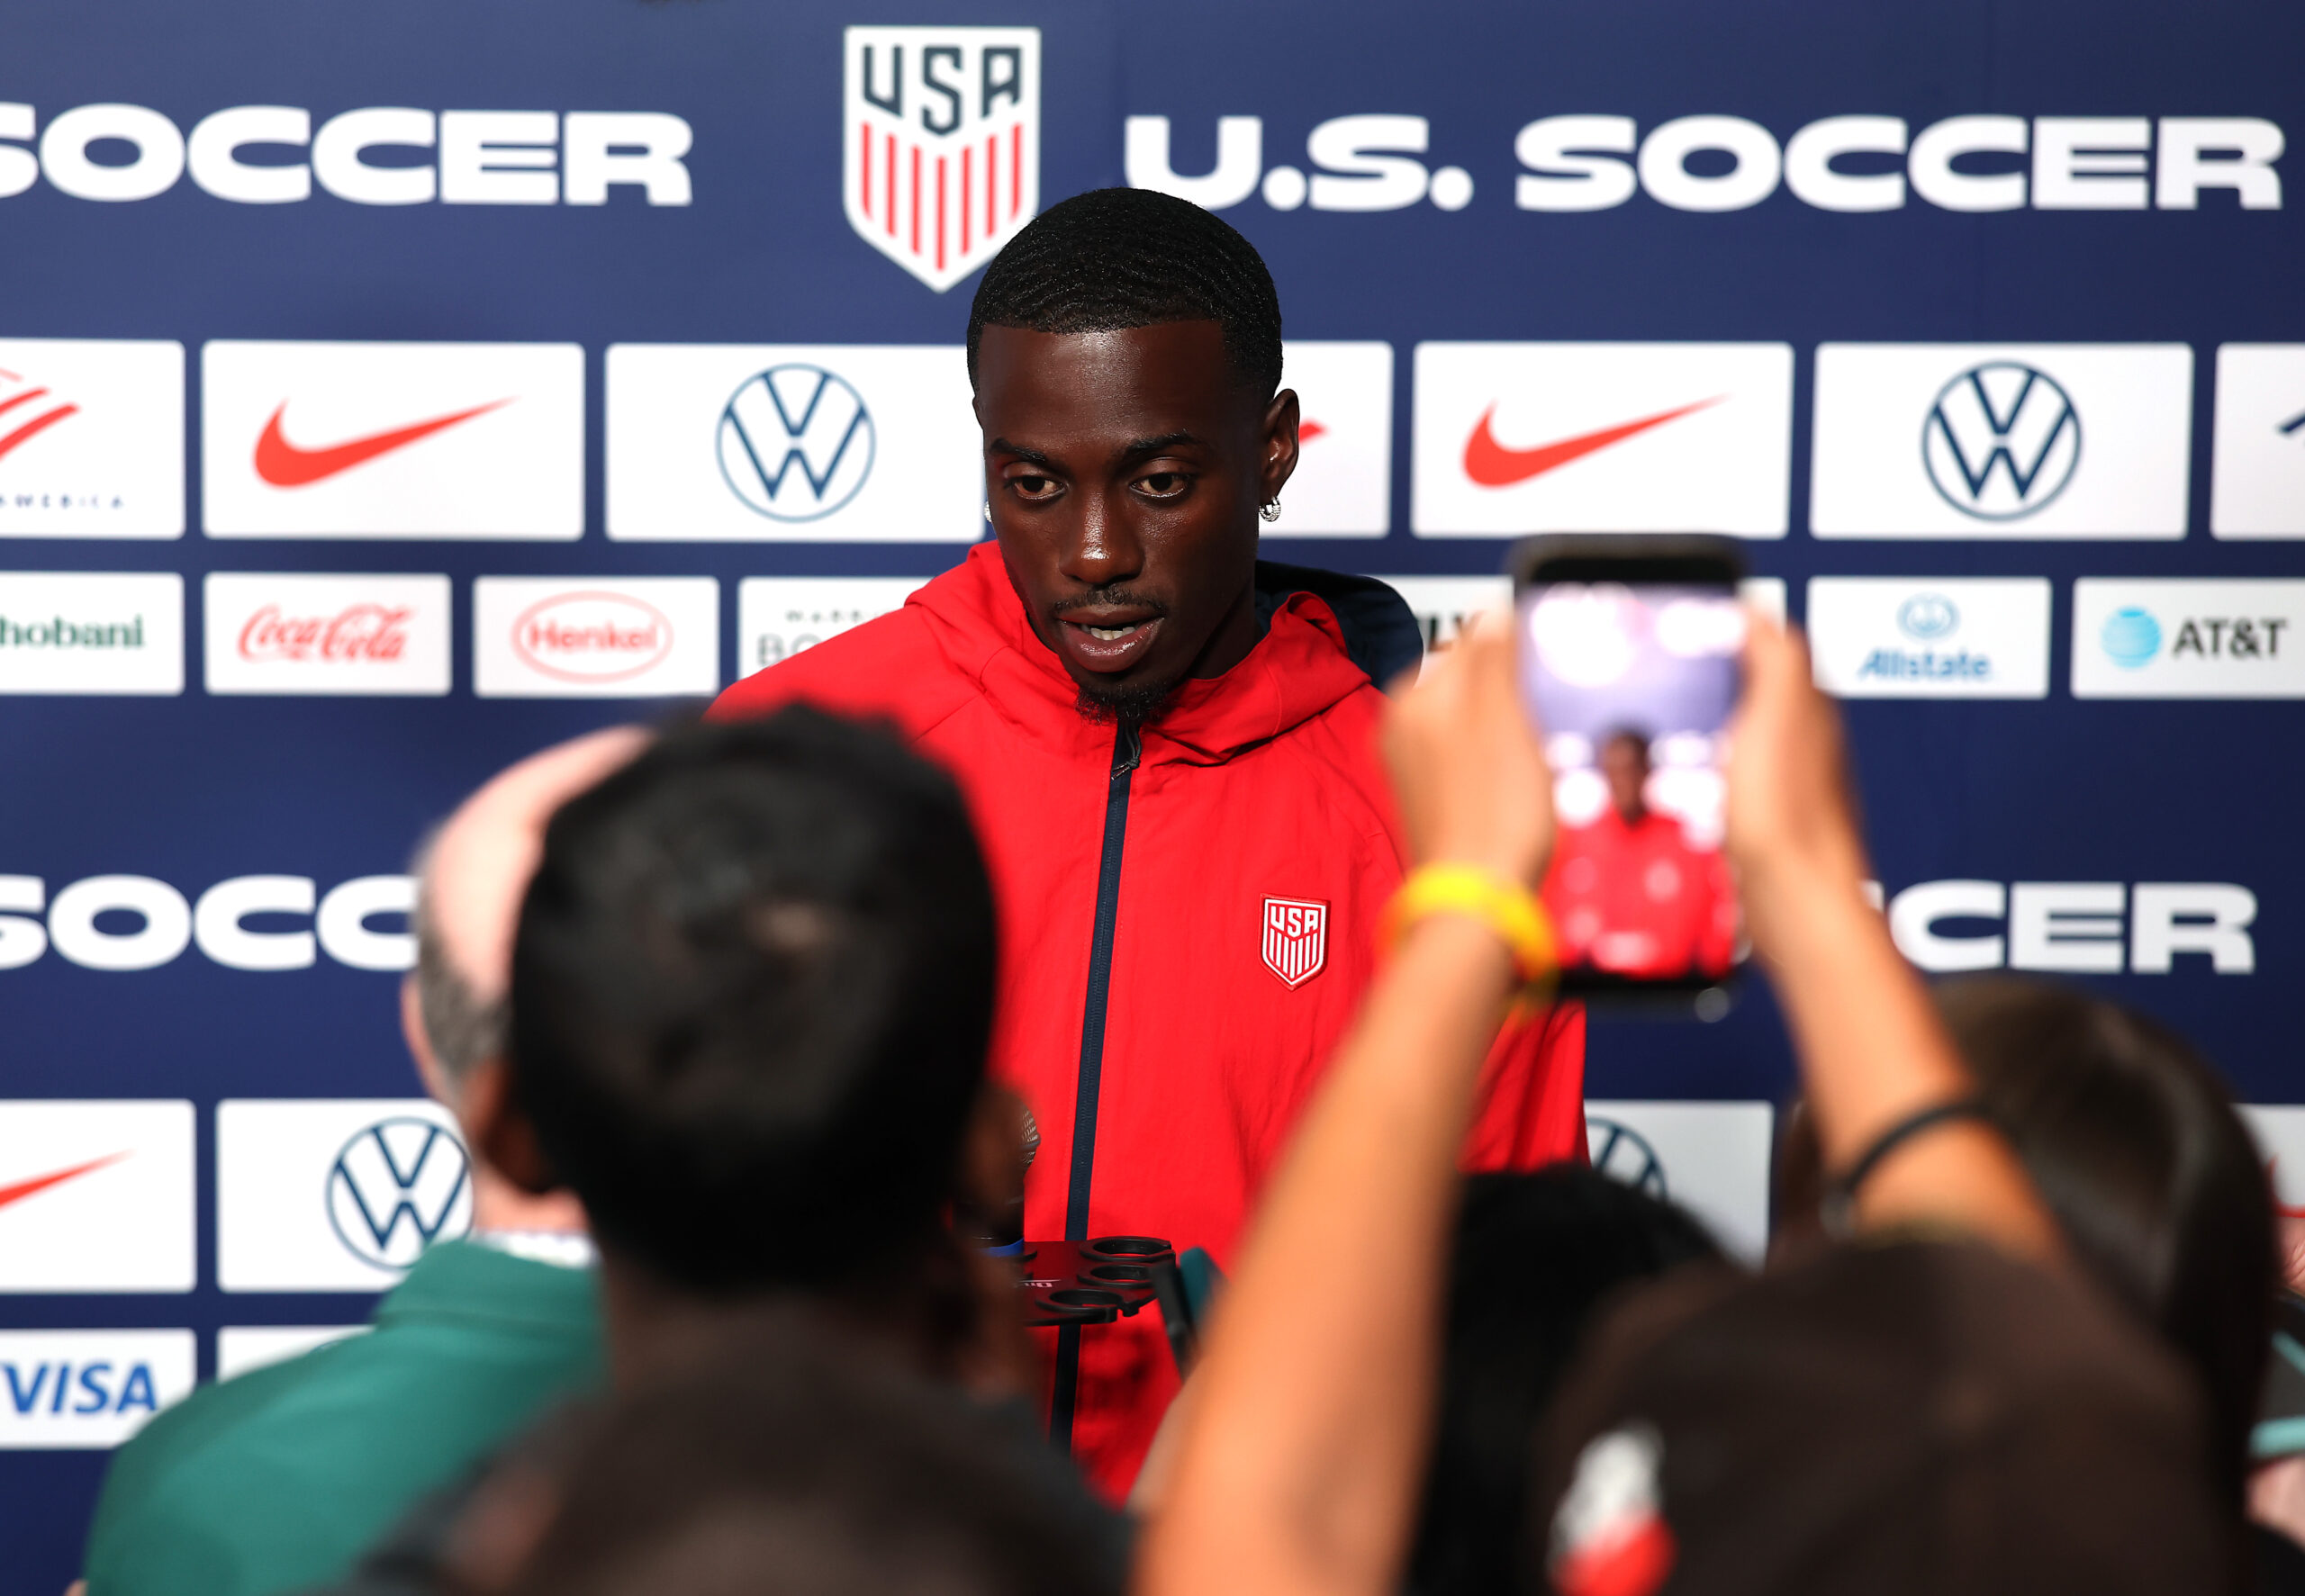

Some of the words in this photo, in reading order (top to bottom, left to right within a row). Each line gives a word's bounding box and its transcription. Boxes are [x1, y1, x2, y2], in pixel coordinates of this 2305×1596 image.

[863, 45, 1023, 136] USA
[1125, 114, 1473, 211] U.S.
[1514, 114, 2285, 212] SOCCER
[2172, 617, 2289, 659] AT&T
[1857, 646, 1993, 681] Allstate
[1270, 906, 1319, 938] USA
[1864, 879, 2256, 973] CER
[2, 1362, 157, 1412] VISA
